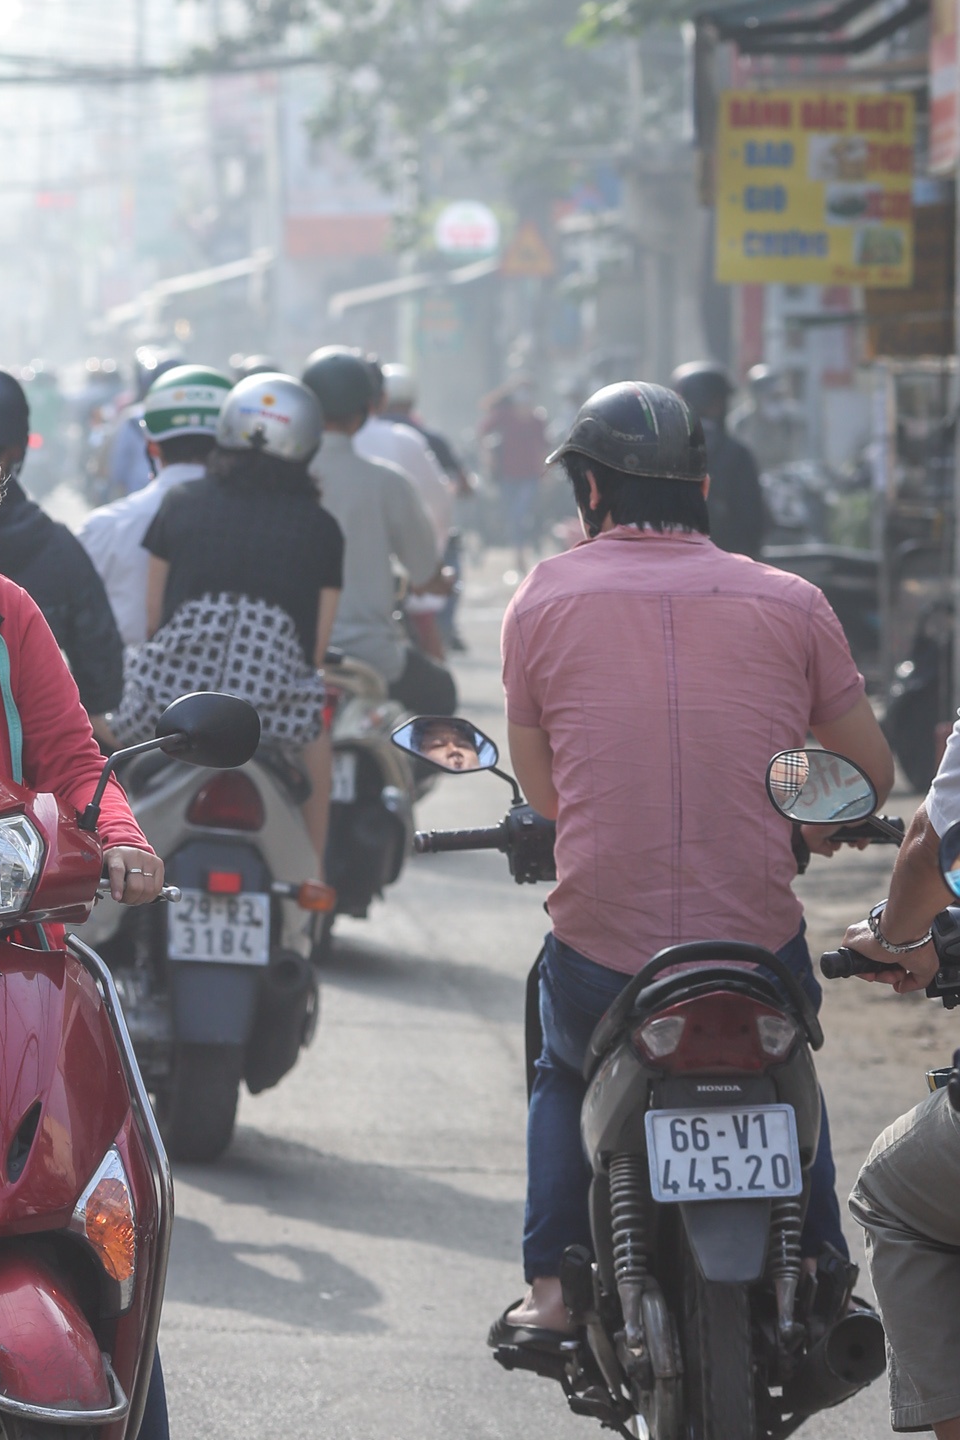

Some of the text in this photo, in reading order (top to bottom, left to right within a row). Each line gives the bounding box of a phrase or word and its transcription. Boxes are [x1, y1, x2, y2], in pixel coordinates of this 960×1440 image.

[181, 927, 253, 956] 3184
[697, 1084, 742, 1093] HONDA
[669, 1114, 768, 1153] 66-V1
[662, 1153, 791, 1195] 445.20
